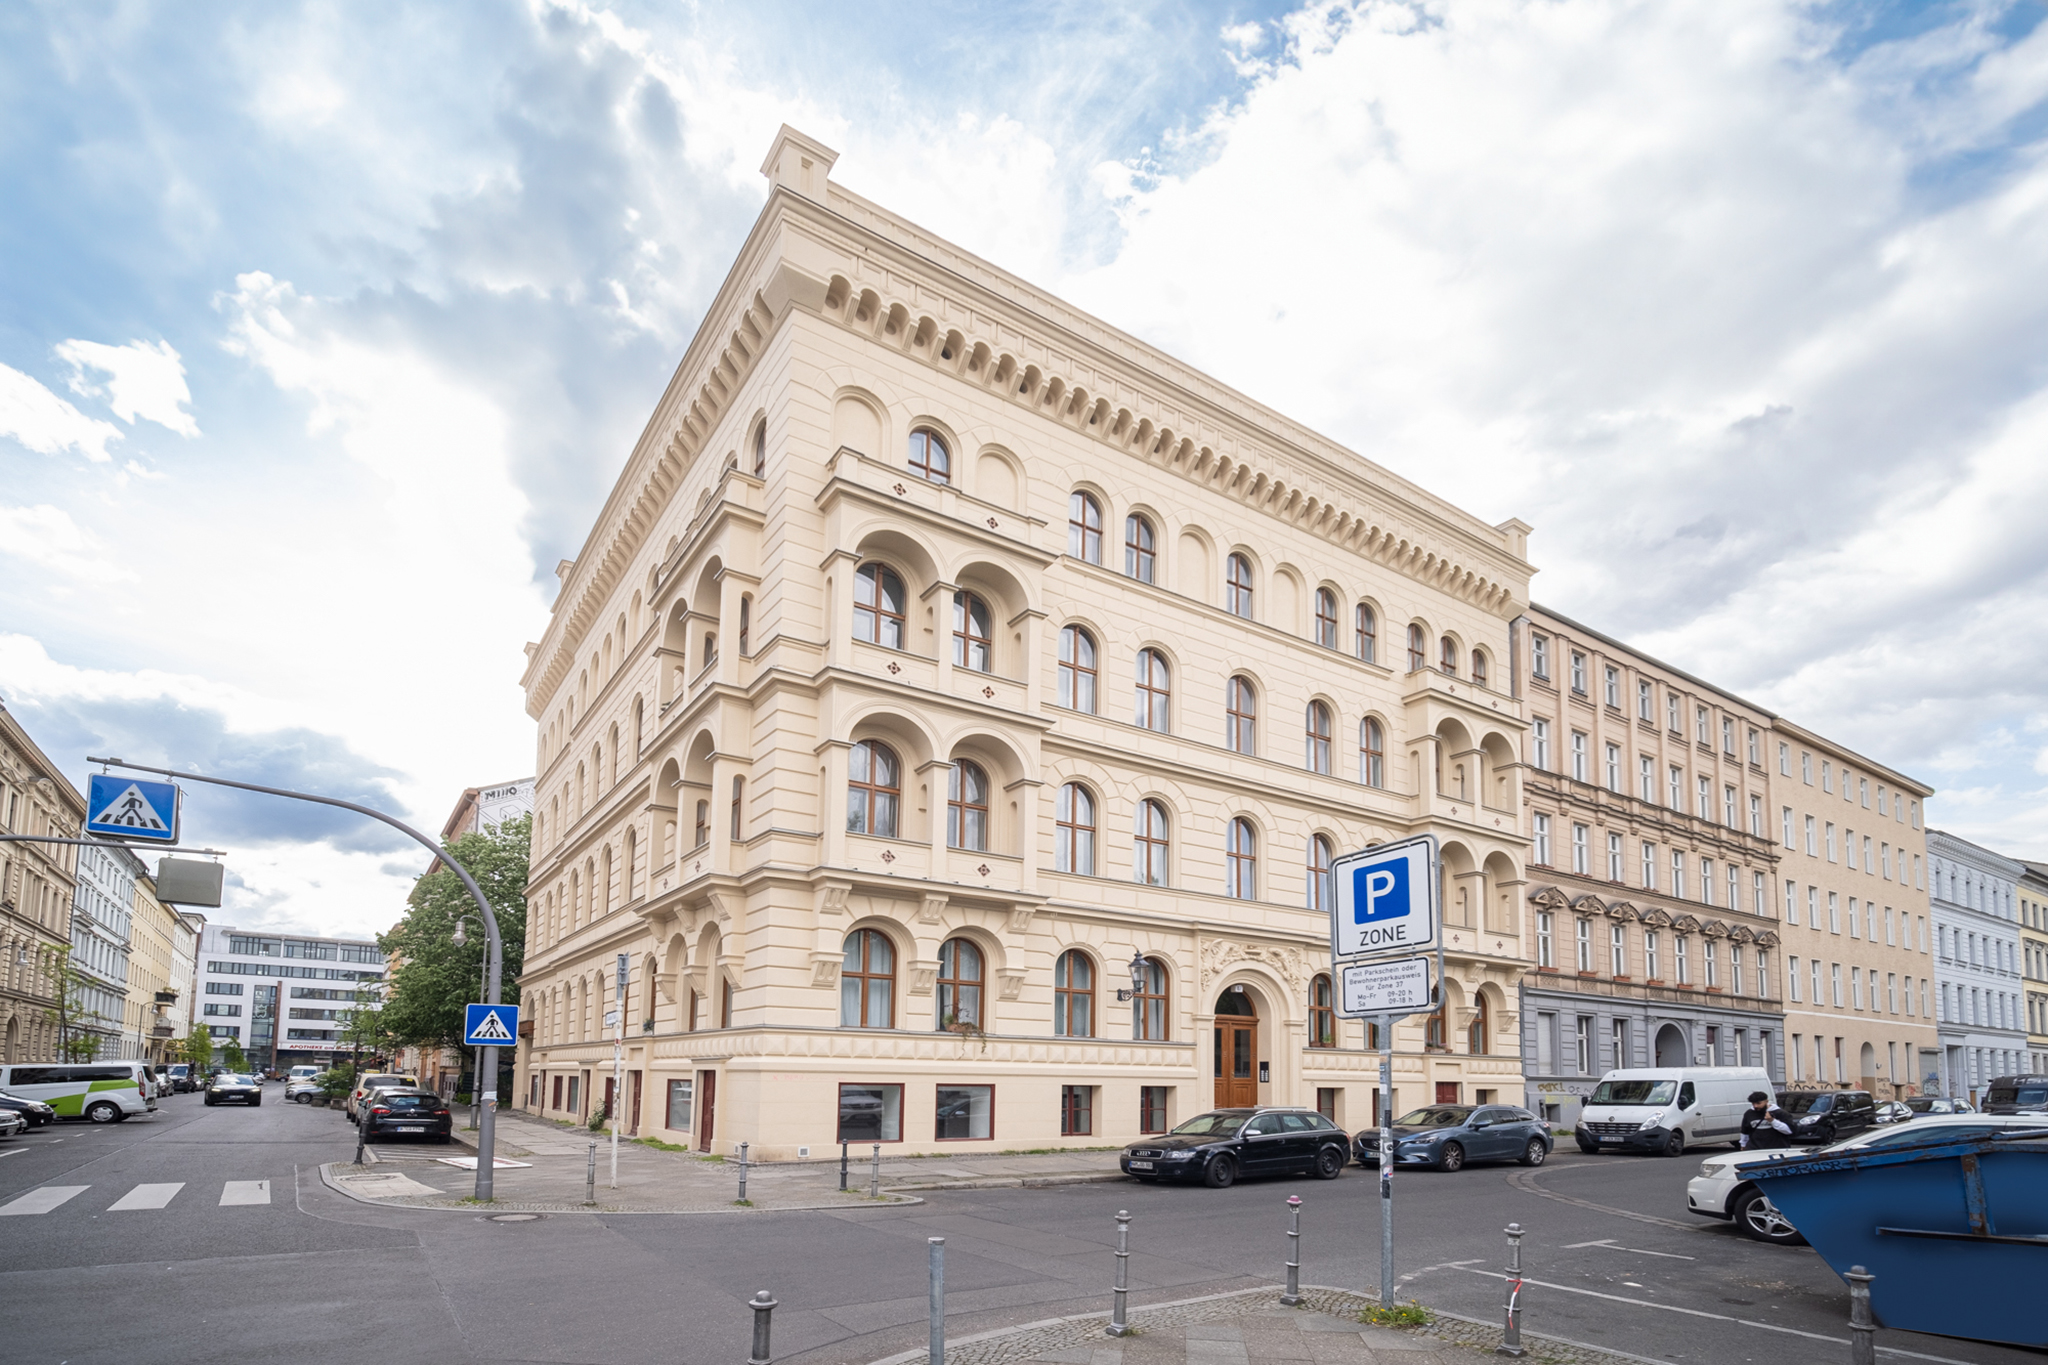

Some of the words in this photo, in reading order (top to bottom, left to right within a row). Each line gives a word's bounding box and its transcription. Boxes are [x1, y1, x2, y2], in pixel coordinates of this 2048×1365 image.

[1366, 870, 1396, 915] P
[1359, 924, 1407, 947] ZONE
[1349, 972, 1421, 985] Bewohnerparkausweis
[1364, 966, 1399, 976] Parkschein
[1401, 964, 1417, 972] oder
